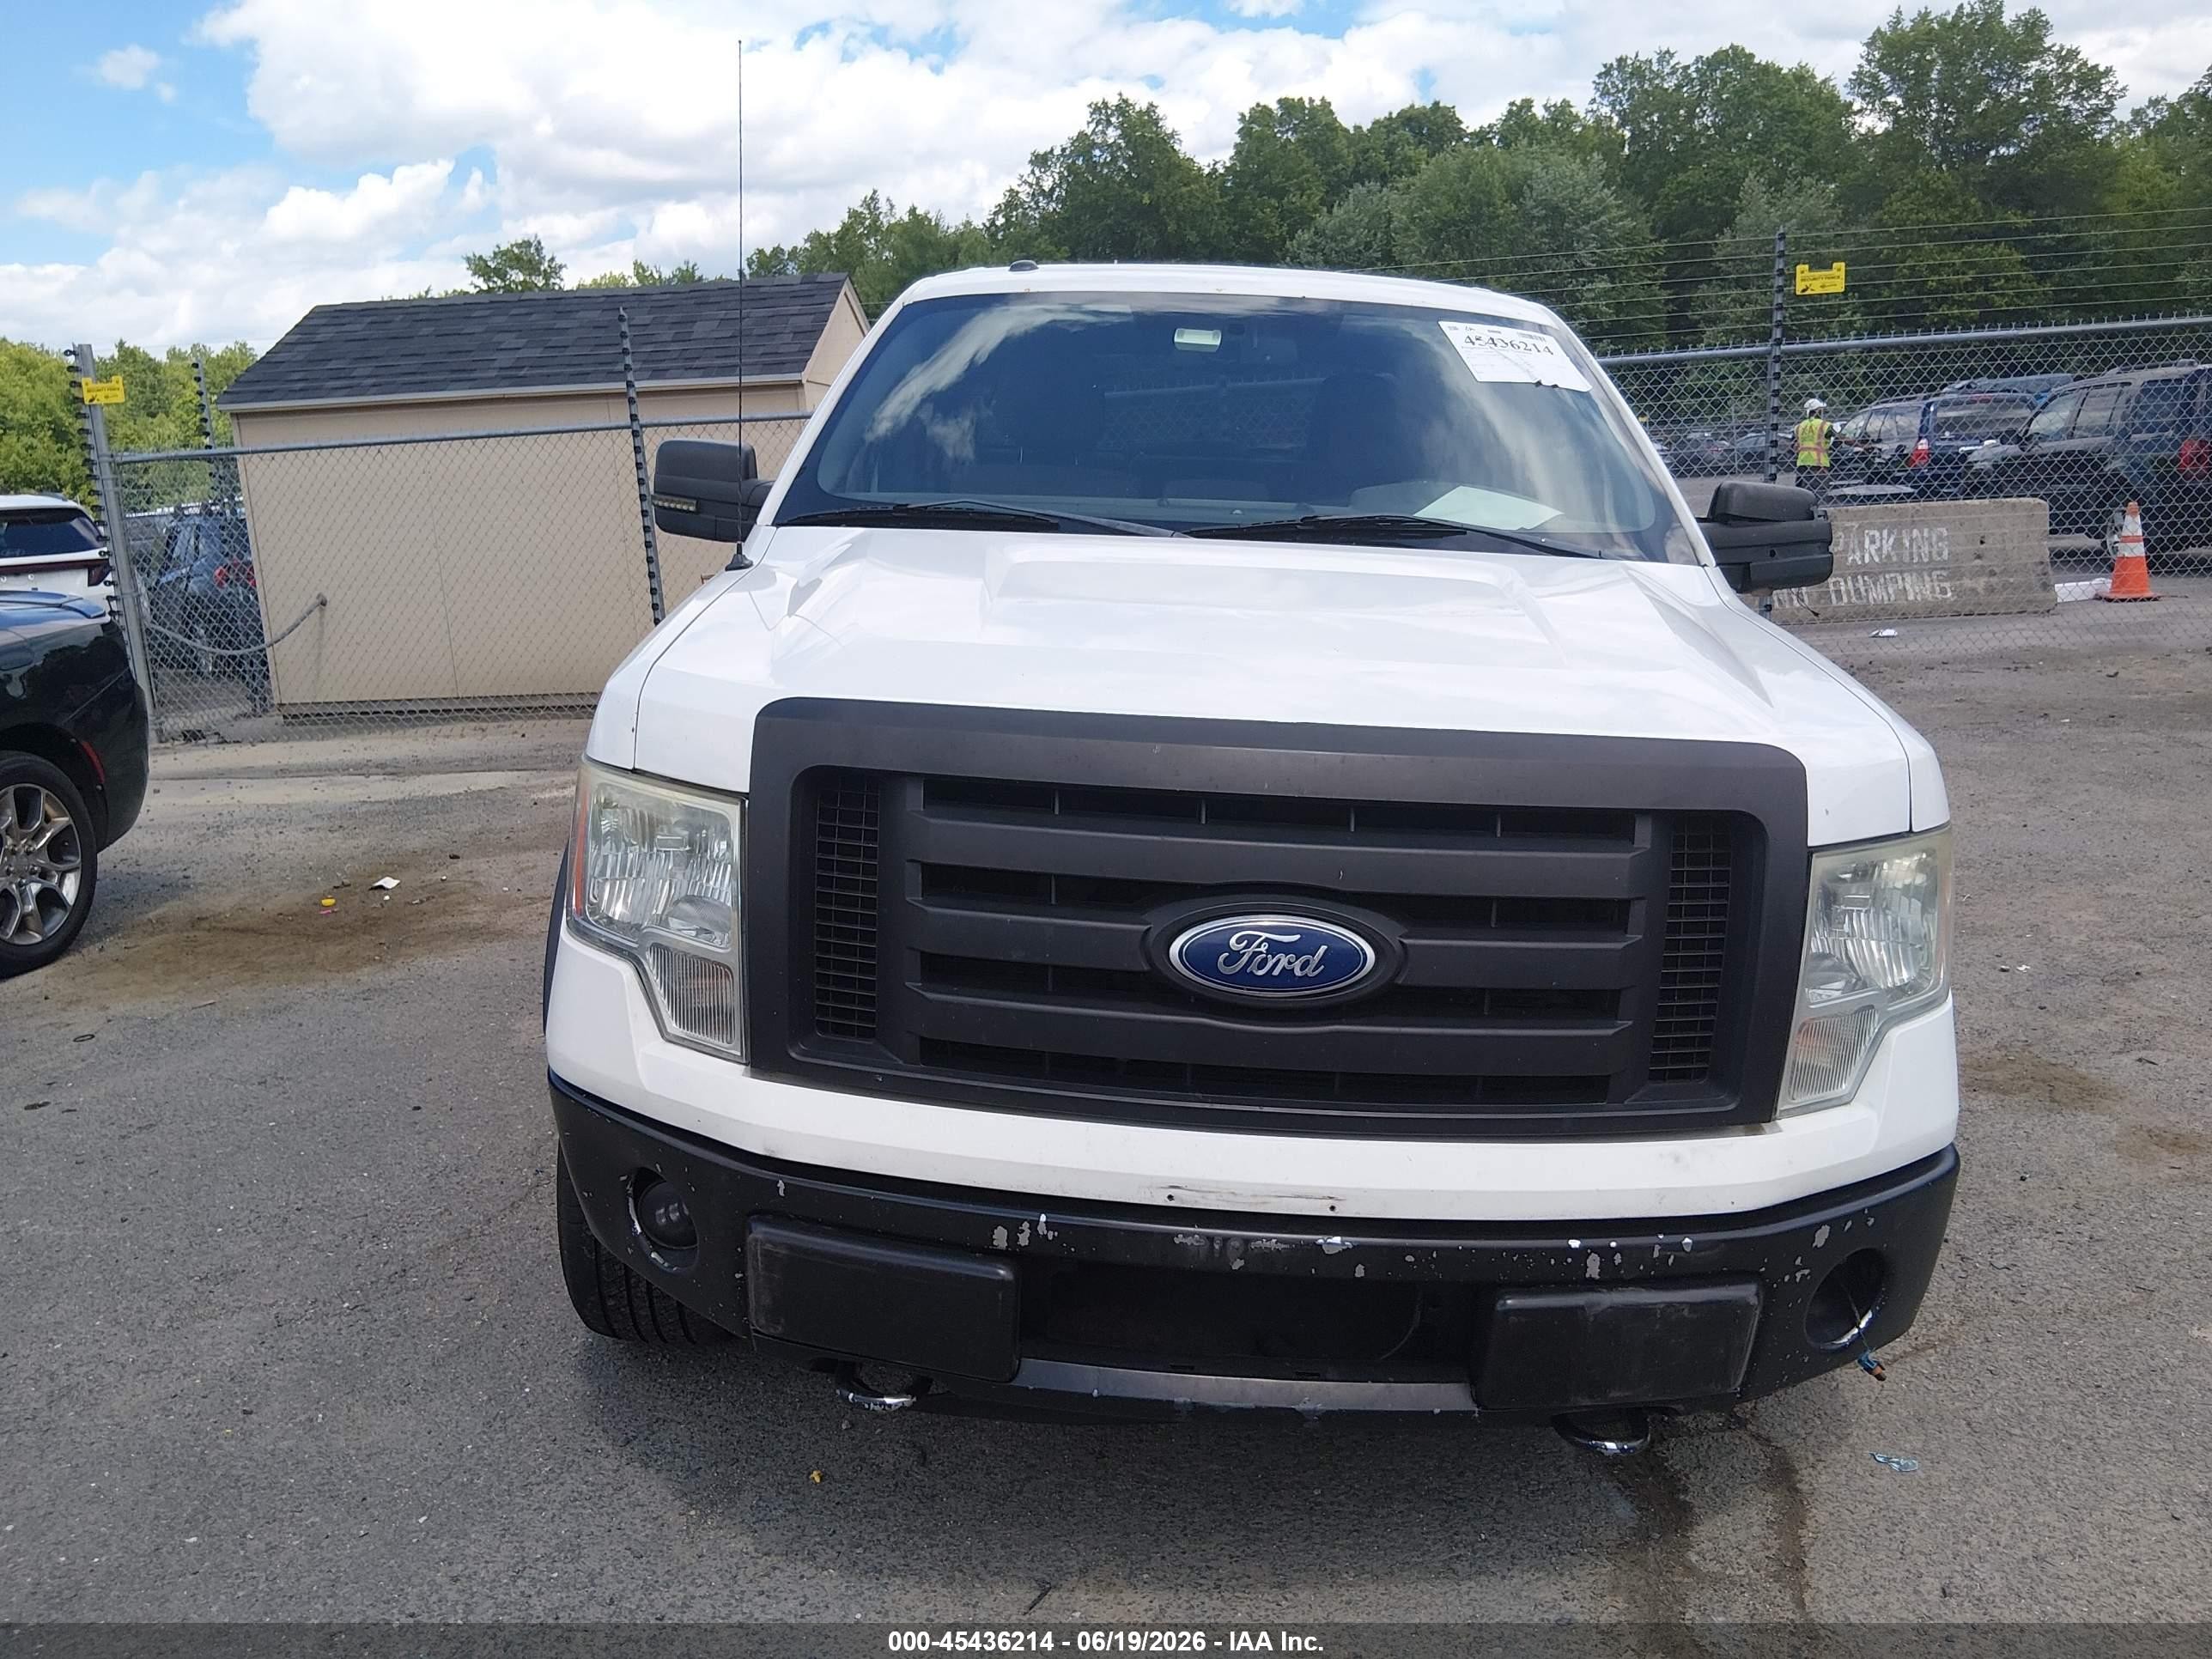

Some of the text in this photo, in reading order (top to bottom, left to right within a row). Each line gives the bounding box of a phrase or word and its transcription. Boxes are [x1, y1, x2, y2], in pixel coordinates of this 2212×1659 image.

[1464, 335, 1553, 356] 45436214
[1829, 570, 1953, 605] DUMPING
[1217, 930, 1328, 977] Ford
